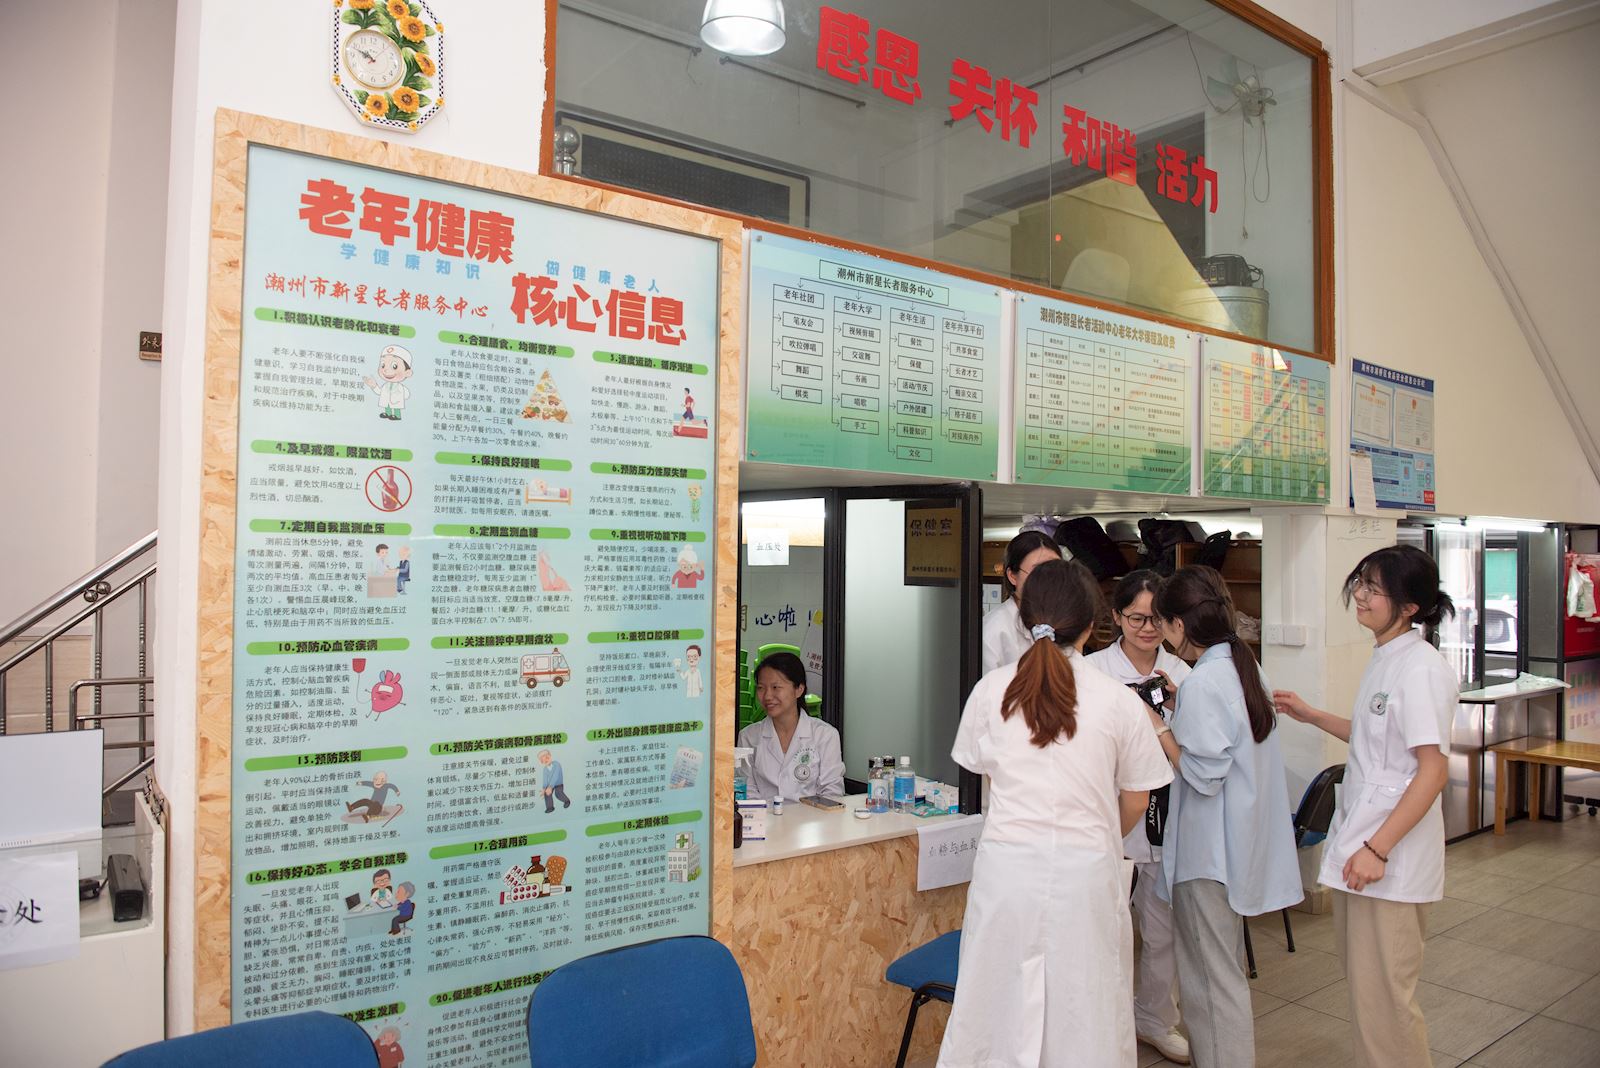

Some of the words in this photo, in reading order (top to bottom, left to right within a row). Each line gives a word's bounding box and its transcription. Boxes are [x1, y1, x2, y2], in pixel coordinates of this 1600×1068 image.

[817, 5, 922, 105] 感恩
[948, 57, 1038, 148] 关怀
[1062, 104, 1137, 186] 和谐
[1155, 142, 1218, 214] 活力
[299, 179, 514, 264] 老年健康
[341, 243, 480, 279] 学健康知识
[546, 260, 660, 293] 做健康老人
[837, 267, 934, 298] 潮州市新星长者服务中心
[265, 273, 489, 318] 潮州市新星长者服务中心
[783, 289, 815, 304] 老年社团
[511, 273, 687, 346] 核心信息
[843, 301, 873, 314] 老年大学
[273, 311, 400, 336] 1.积极认识老龄化和衰老
[793, 316, 814, 328] 笔友会
[898, 312, 926, 325] 老年生活
[944, 321, 982, 336] 老年共享平台
[459, 334, 557, 355] 2.合理膳食，均衡营养
[789, 340, 816, 353] 吹拉弹唱
[852, 350, 871, 361] 交谊舞
[795, 365, 810, 376] 舞蹈
[909, 360, 922, 370] 保健
[855, 374, 867, 384] 书画
[795, 389, 809, 399] 棋类
[854, 398, 867, 407] 唱歌
[903, 403, 927, 414] 户外团建
[853, 421, 866, 430] 手工
[276, 443, 392, 460] 4.及早戒烟，限量饮酒
[909, 449, 921, 458] 文化
[472, 455, 540, 469] 5.保持良好睡眠
[612, 464, 688, 478] 6.预防压力性尿失禁
[280, 521, 385, 534] 7.定期自我监测血压
[470, 526, 538, 538] 8.定期监测血糖
[611, 530, 687, 541] 9.重视视听功能下降
[616, 630, 680, 641] 12.重视口腔保健
[279, 639, 378, 653] 10.预防心血管疾病
[593, 721, 698, 738] 15.外出随身携带健康应急卡
[438, 733, 562, 753] 14.预防关节疾病和骨质疏松
[298, 750, 361, 765] 13.预防跌倒
[623, 815, 669, 829] 18.定期体检
[474, 835, 528, 851] 17.合理用药
[250, 852, 407, 882] 16.保持好心态，学会自我疏导
